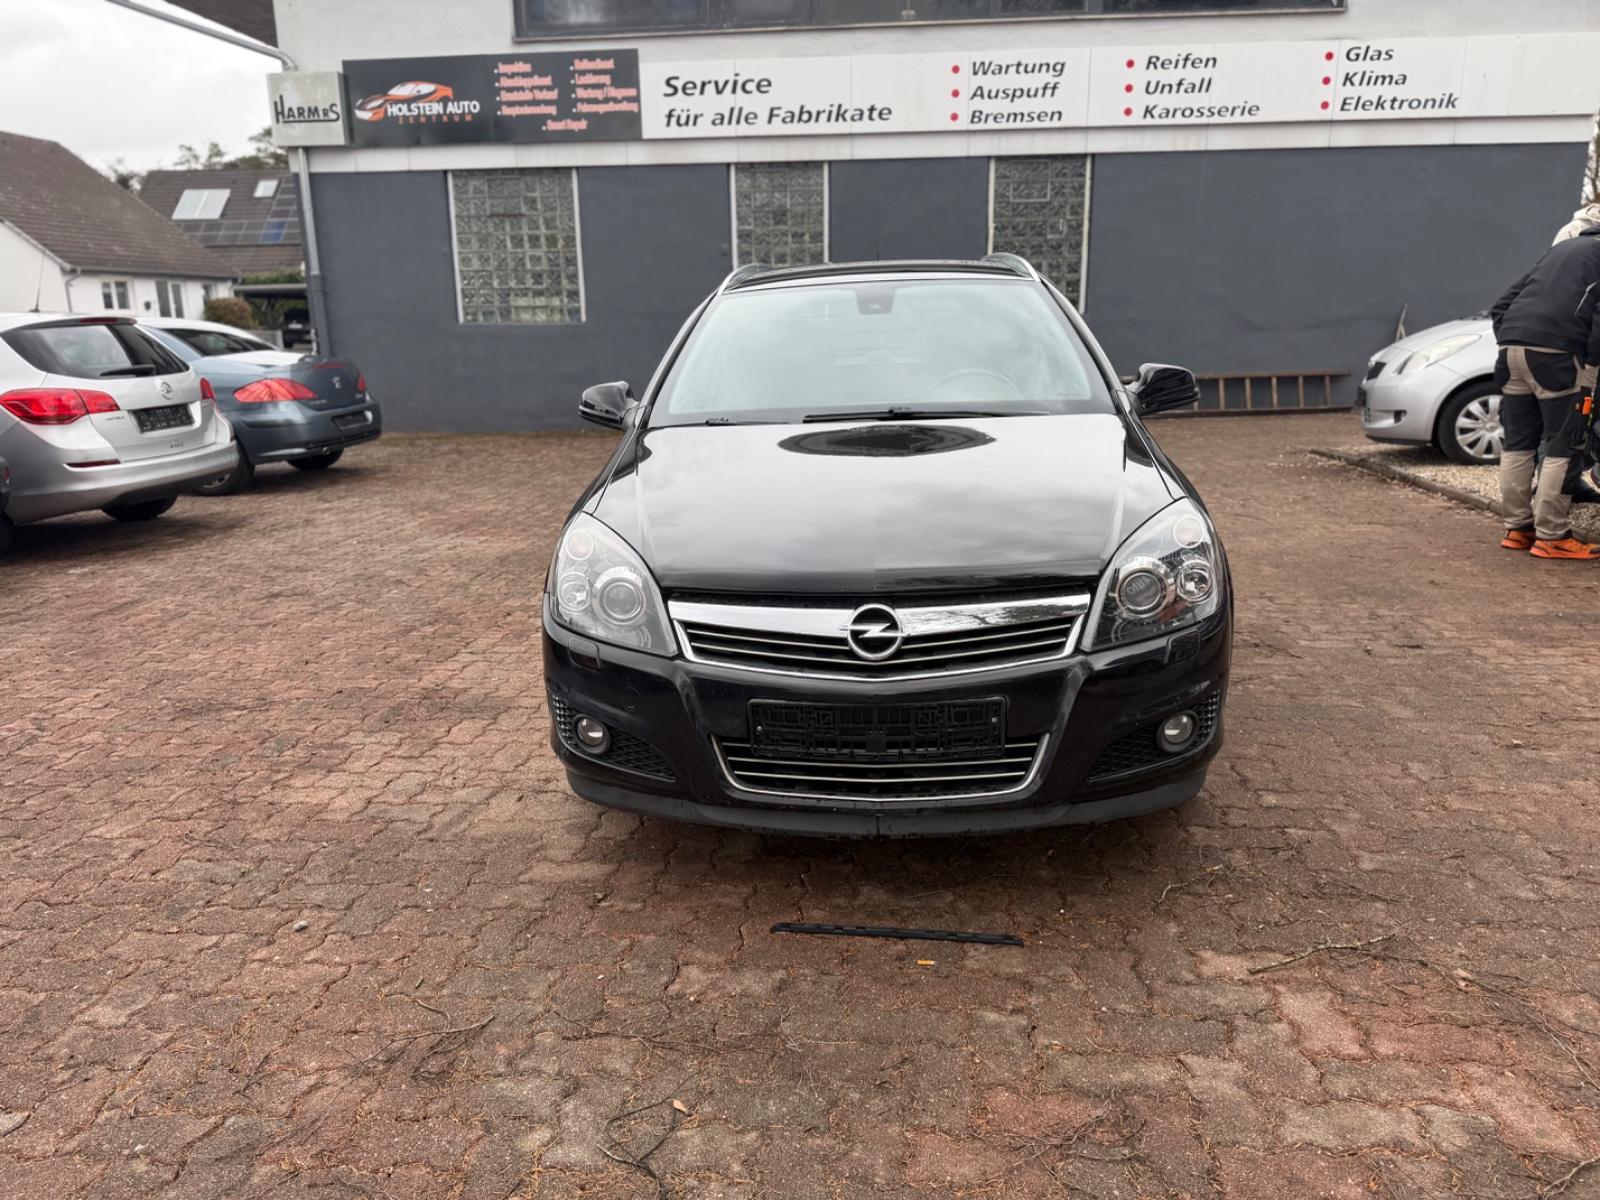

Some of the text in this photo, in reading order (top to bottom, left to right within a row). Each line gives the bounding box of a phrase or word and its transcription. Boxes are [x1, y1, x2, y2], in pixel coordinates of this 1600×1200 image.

[1145, 53, 1218, 70] Reifen
[1345, 45, 1395, 62] Glas
[972, 60, 1066, 78] Wartung
[663, 73, 773, 97] Service
[1144, 77, 1213, 95] Unfall
[1342, 70, 1408, 87] Klima
[969, 81, 1061, 103] Auspuff
[387, 100, 481, 117] HOLSTEIN AUTO
[1142, 101, 1261, 119] Karosserie
[1340, 93, 1459, 112] Elektronik
[399, 114, 473, 125] ZENTRUM
[665, 103, 893, 128] für alle Fabrikate
[969, 109, 1063, 124] Bremsen
